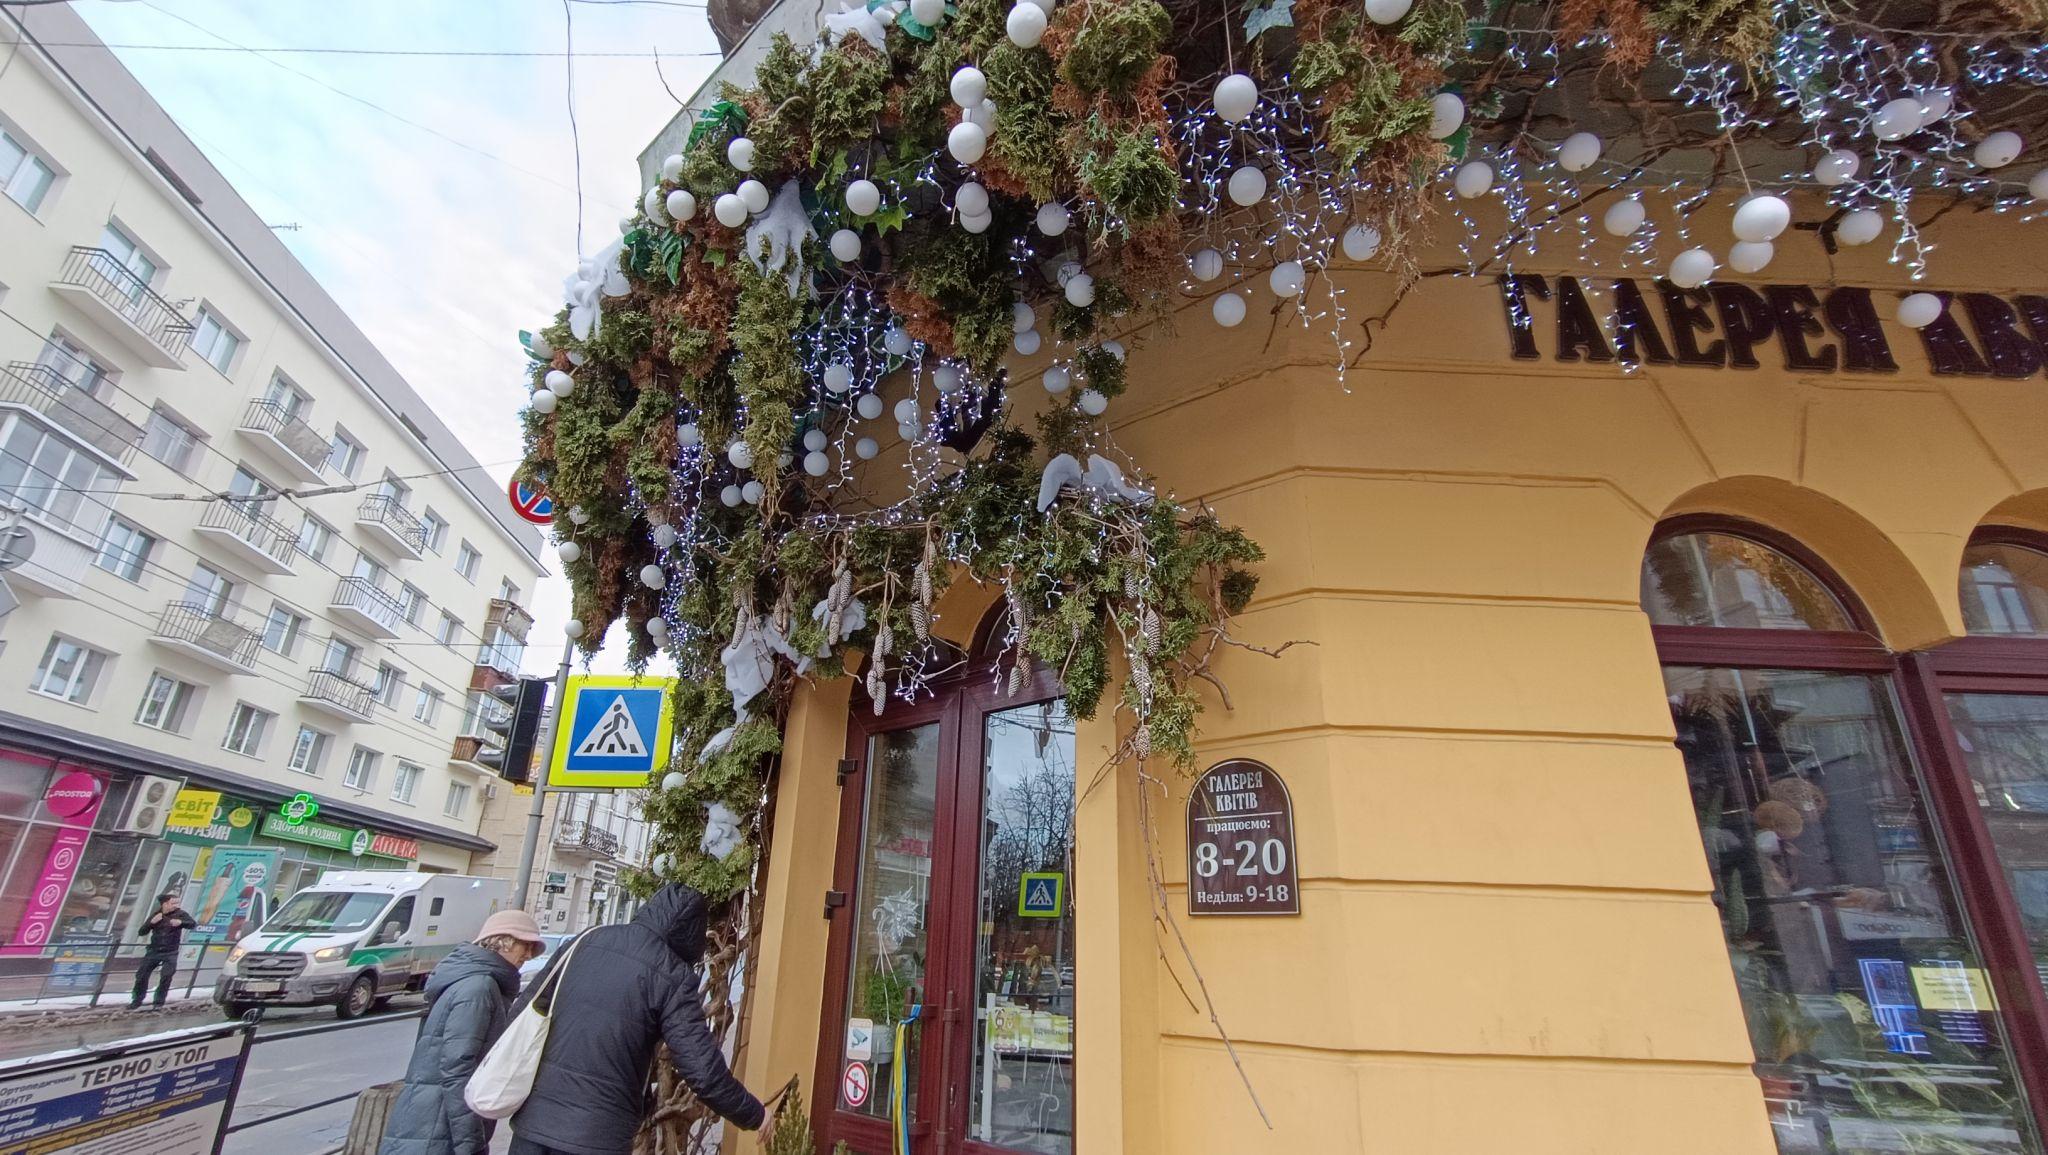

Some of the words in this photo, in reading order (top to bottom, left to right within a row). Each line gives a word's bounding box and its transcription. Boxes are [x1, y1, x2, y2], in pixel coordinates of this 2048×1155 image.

[1498, 273, 1899, 372] ГАЛЕРЕЯ
[1209, 772, 1263, 792] ГАЛЕРЕЯ
[53, 789, 92, 799] PROSTOR
[1216, 792, 1258, 812] КВІТІВ
[270, 819, 308, 835] ЗДОРОВА
[310, 826, 342, 842] РОДИНА
[1207, 819, 1271, 834] працюємо:
[369, 834, 418, 859] АПТЕКА
[1196, 838, 1287, 878] 8-20
[1197, 890, 1244, 905] Неділя:
[1246, 884, 1289, 903] 9-18
[81, 1057, 152, 1088] ТЕРНО
[173, 1046, 210, 1067] ТОП
